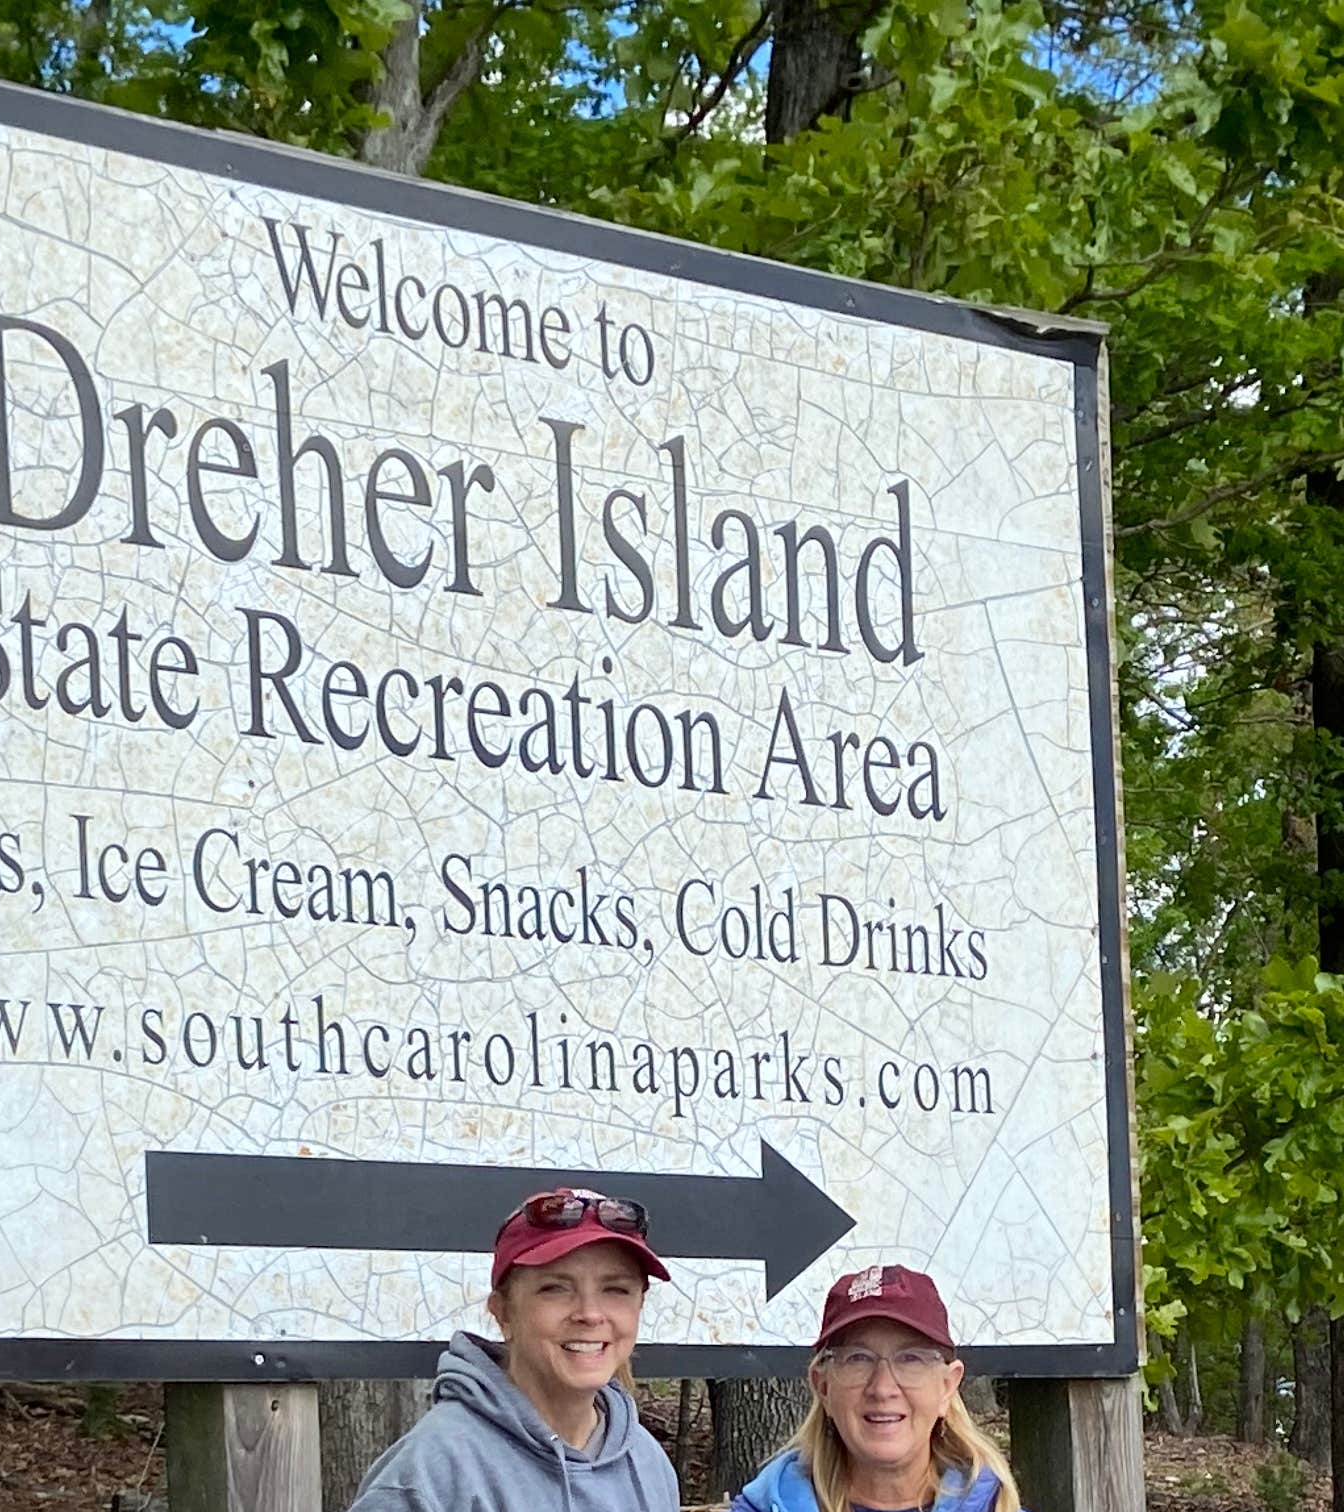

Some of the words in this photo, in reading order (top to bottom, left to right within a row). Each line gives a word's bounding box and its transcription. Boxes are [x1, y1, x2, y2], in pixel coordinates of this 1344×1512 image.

[261, 215, 573, 370] Welcome
[594, 298, 656, 388] to
[538, 415, 927, 669] Island
[234, 606, 729, 796] Recreation
[751, 686, 948, 824] Area
[70, 813, 169, 907] Ice
[191, 828, 420, 946] Cream,
[440, 853, 656, 964] Snacks,
[674, 878, 802, 965] Cold
[817, 892, 990, 985] Drinks
